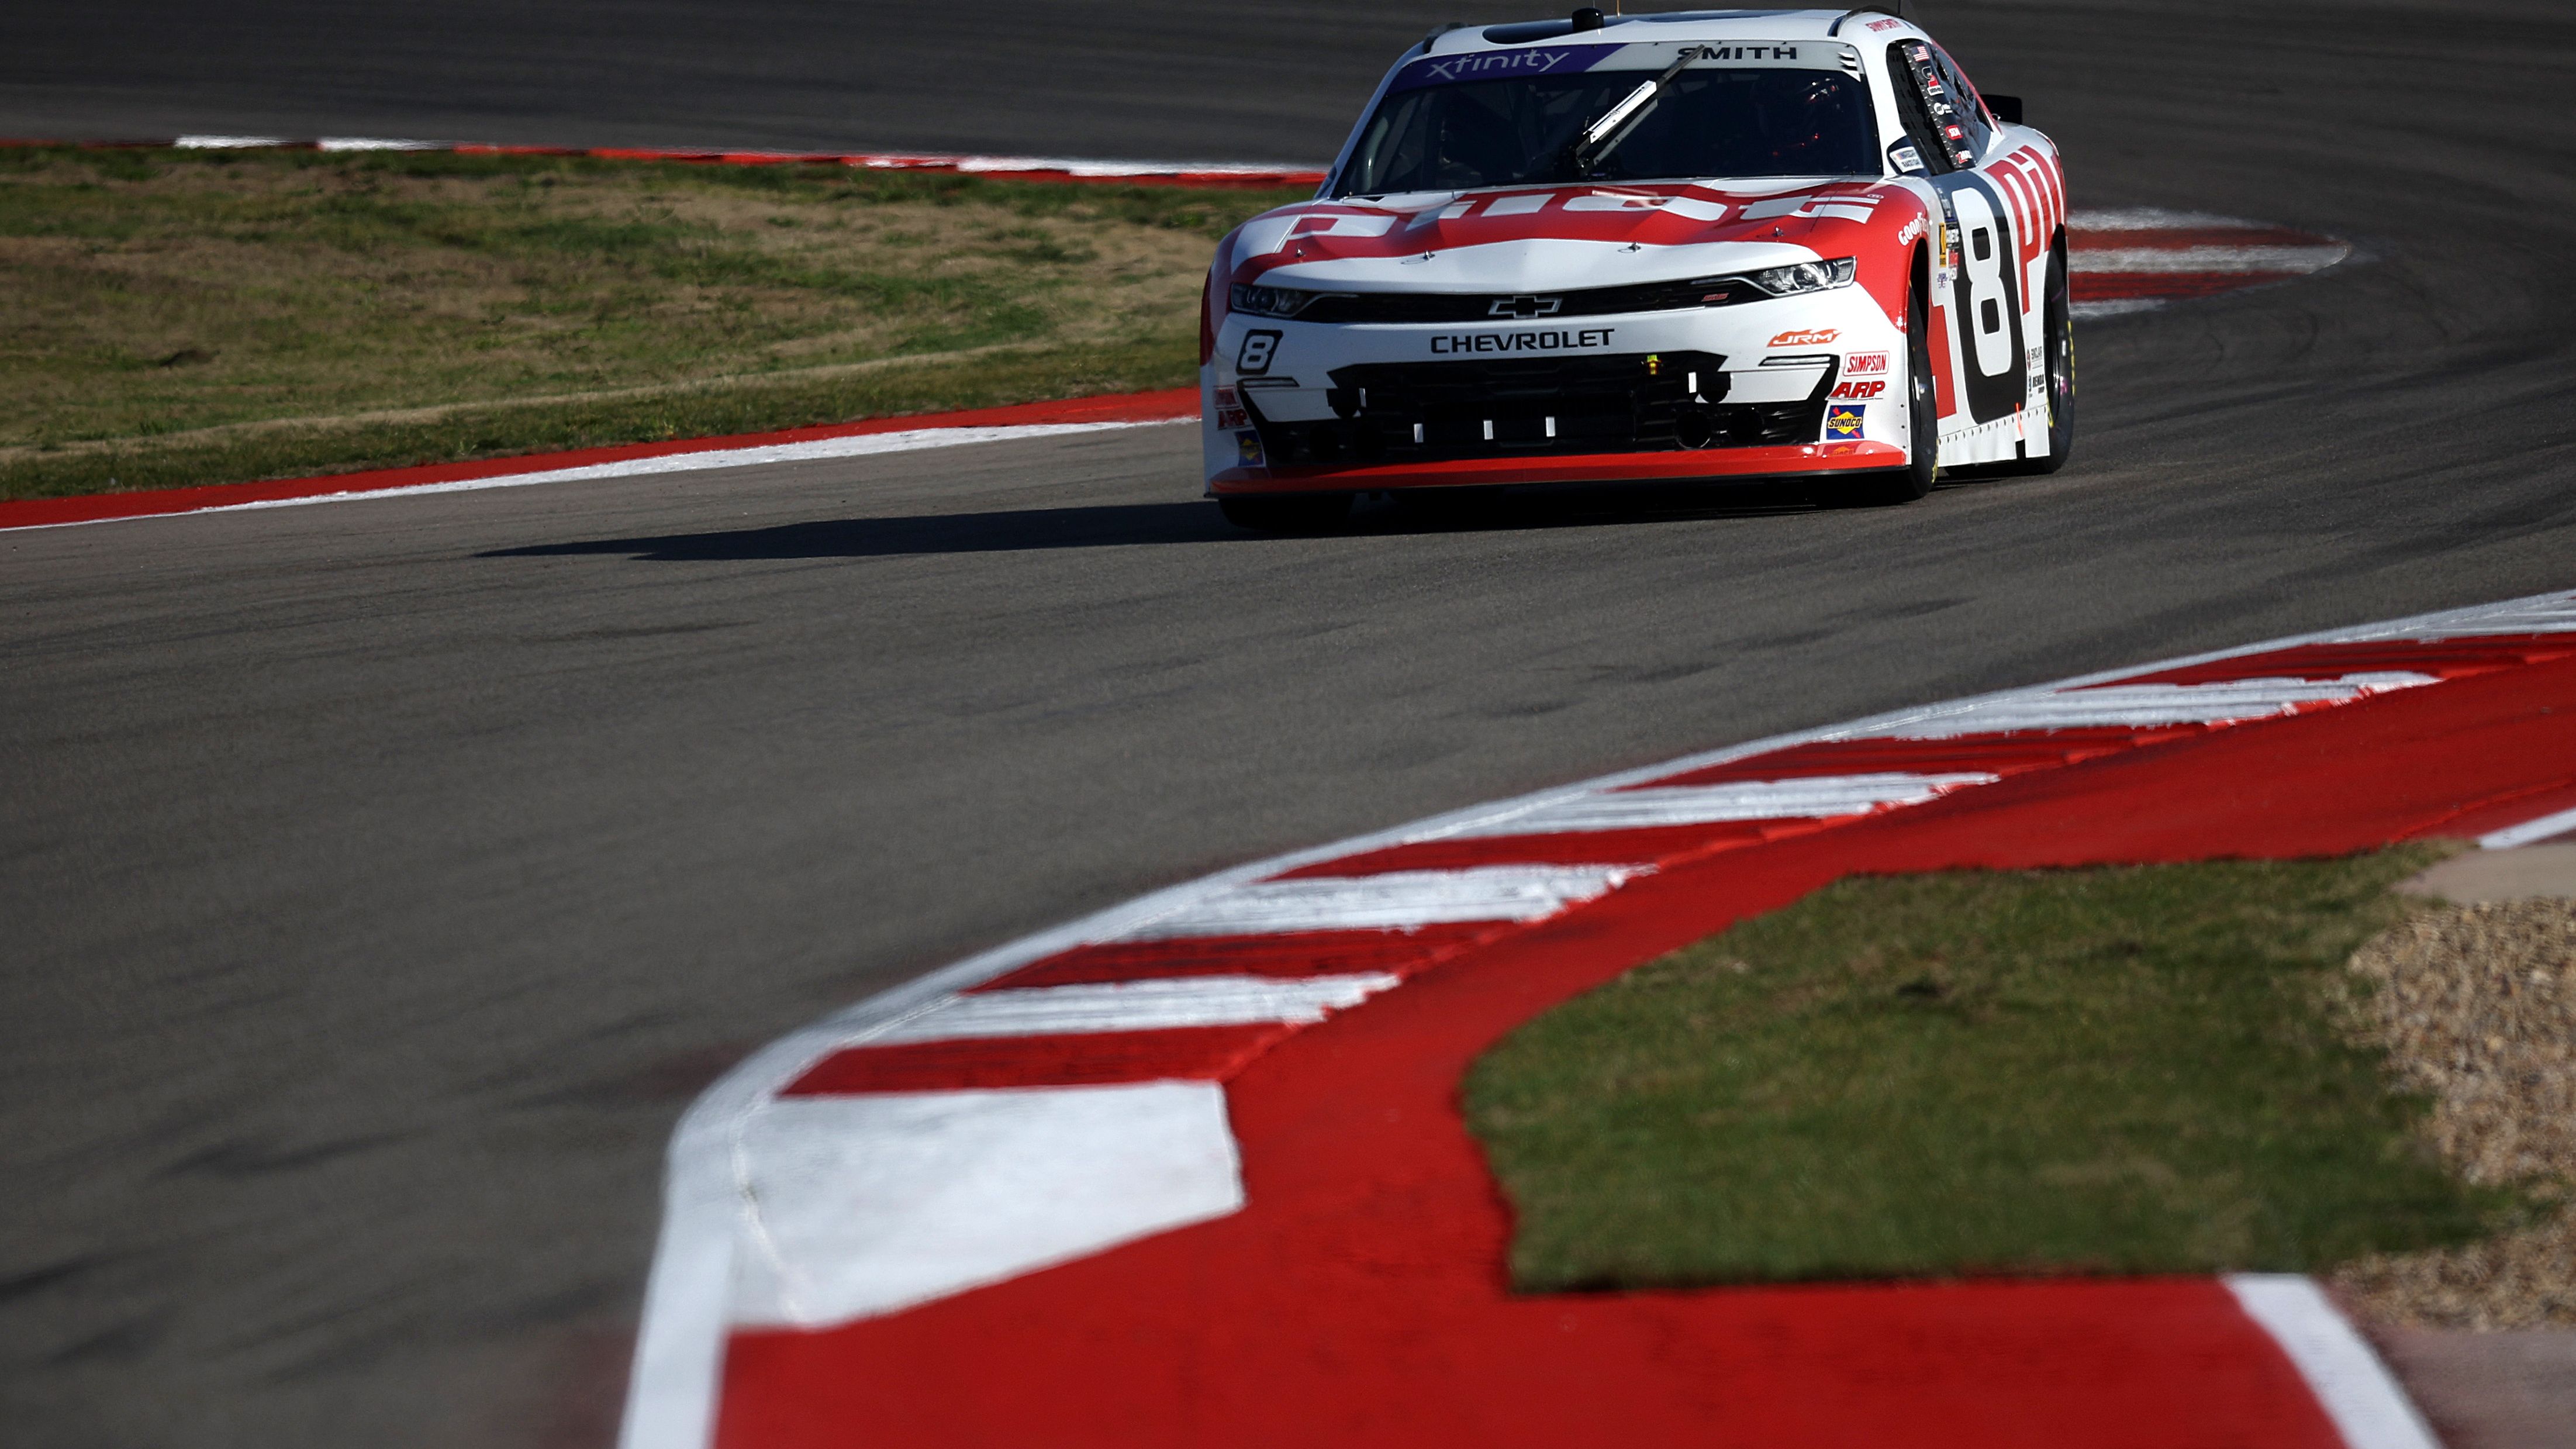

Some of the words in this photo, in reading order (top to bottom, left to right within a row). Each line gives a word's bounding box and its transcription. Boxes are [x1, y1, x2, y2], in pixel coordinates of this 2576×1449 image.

[1677, 47, 1797, 60] SMITH
[1427, 49, 1570, 80] xfinity
[1949, 185, 2014, 383] 8
[1431, 329, 1615, 353] CHEVROLET
[1773, 332, 1833, 345] JRM
[1238, 332, 1279, 372] 8
[1847, 354, 1887, 372] SIMPSON
[1829, 380, 1886, 398] ARP
[1829, 418, 1862, 427] SUNOCO
